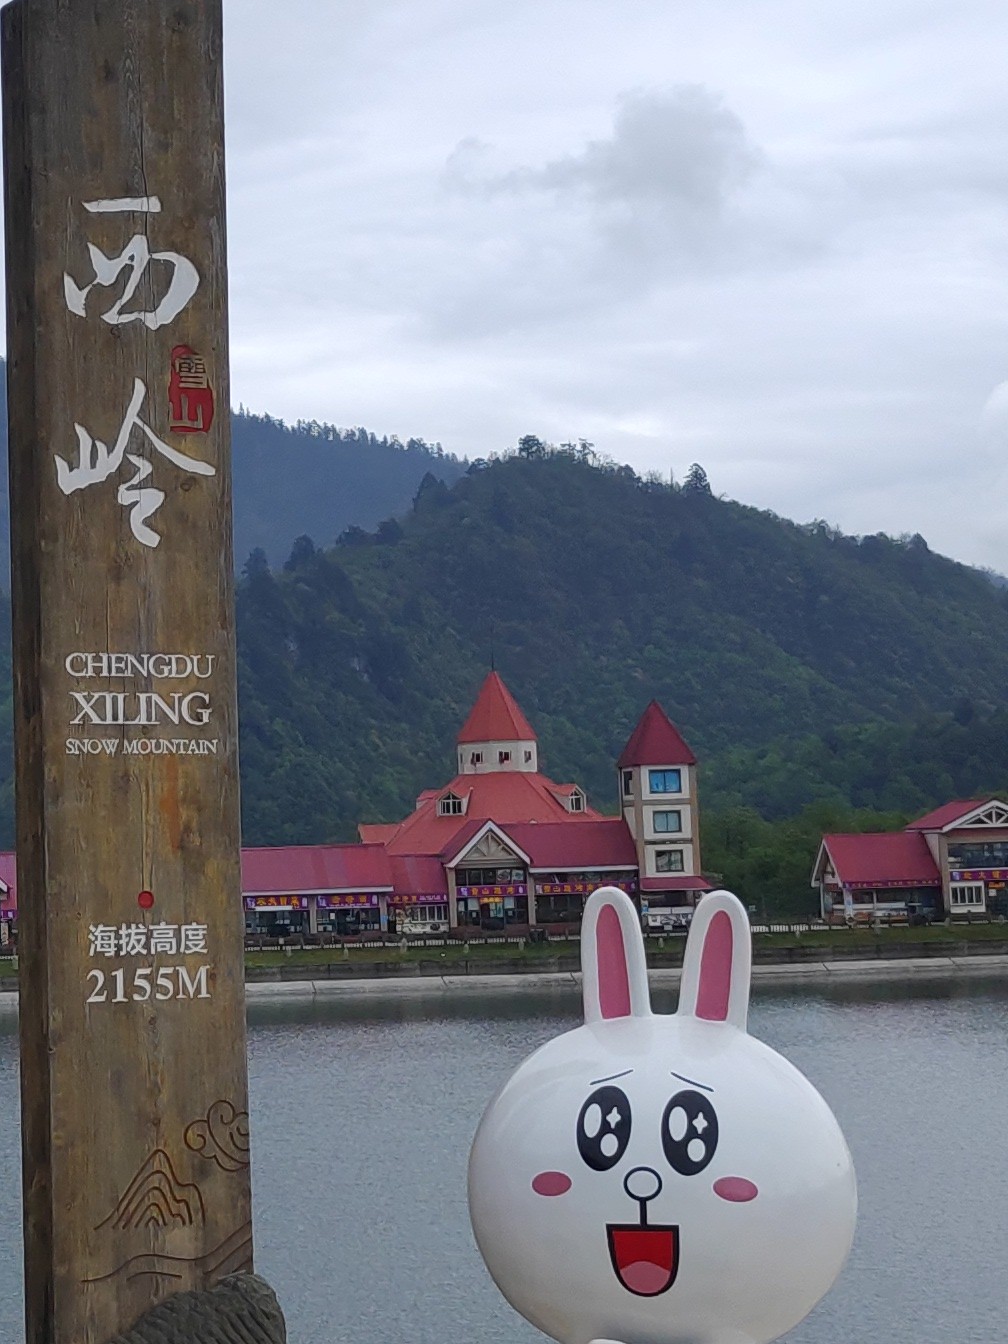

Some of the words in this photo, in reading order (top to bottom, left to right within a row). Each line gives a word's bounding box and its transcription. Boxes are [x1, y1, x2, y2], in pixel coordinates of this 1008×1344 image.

[65, 652, 216, 678] CHENGDU
[69, 691, 213, 726] XILING
[65, 738, 119, 755] SNOW
[122, 737, 218, 755] MOUNTAIN
[88, 921, 208, 957] 海拔高度
[86, 965, 212, 1003] 2155M
